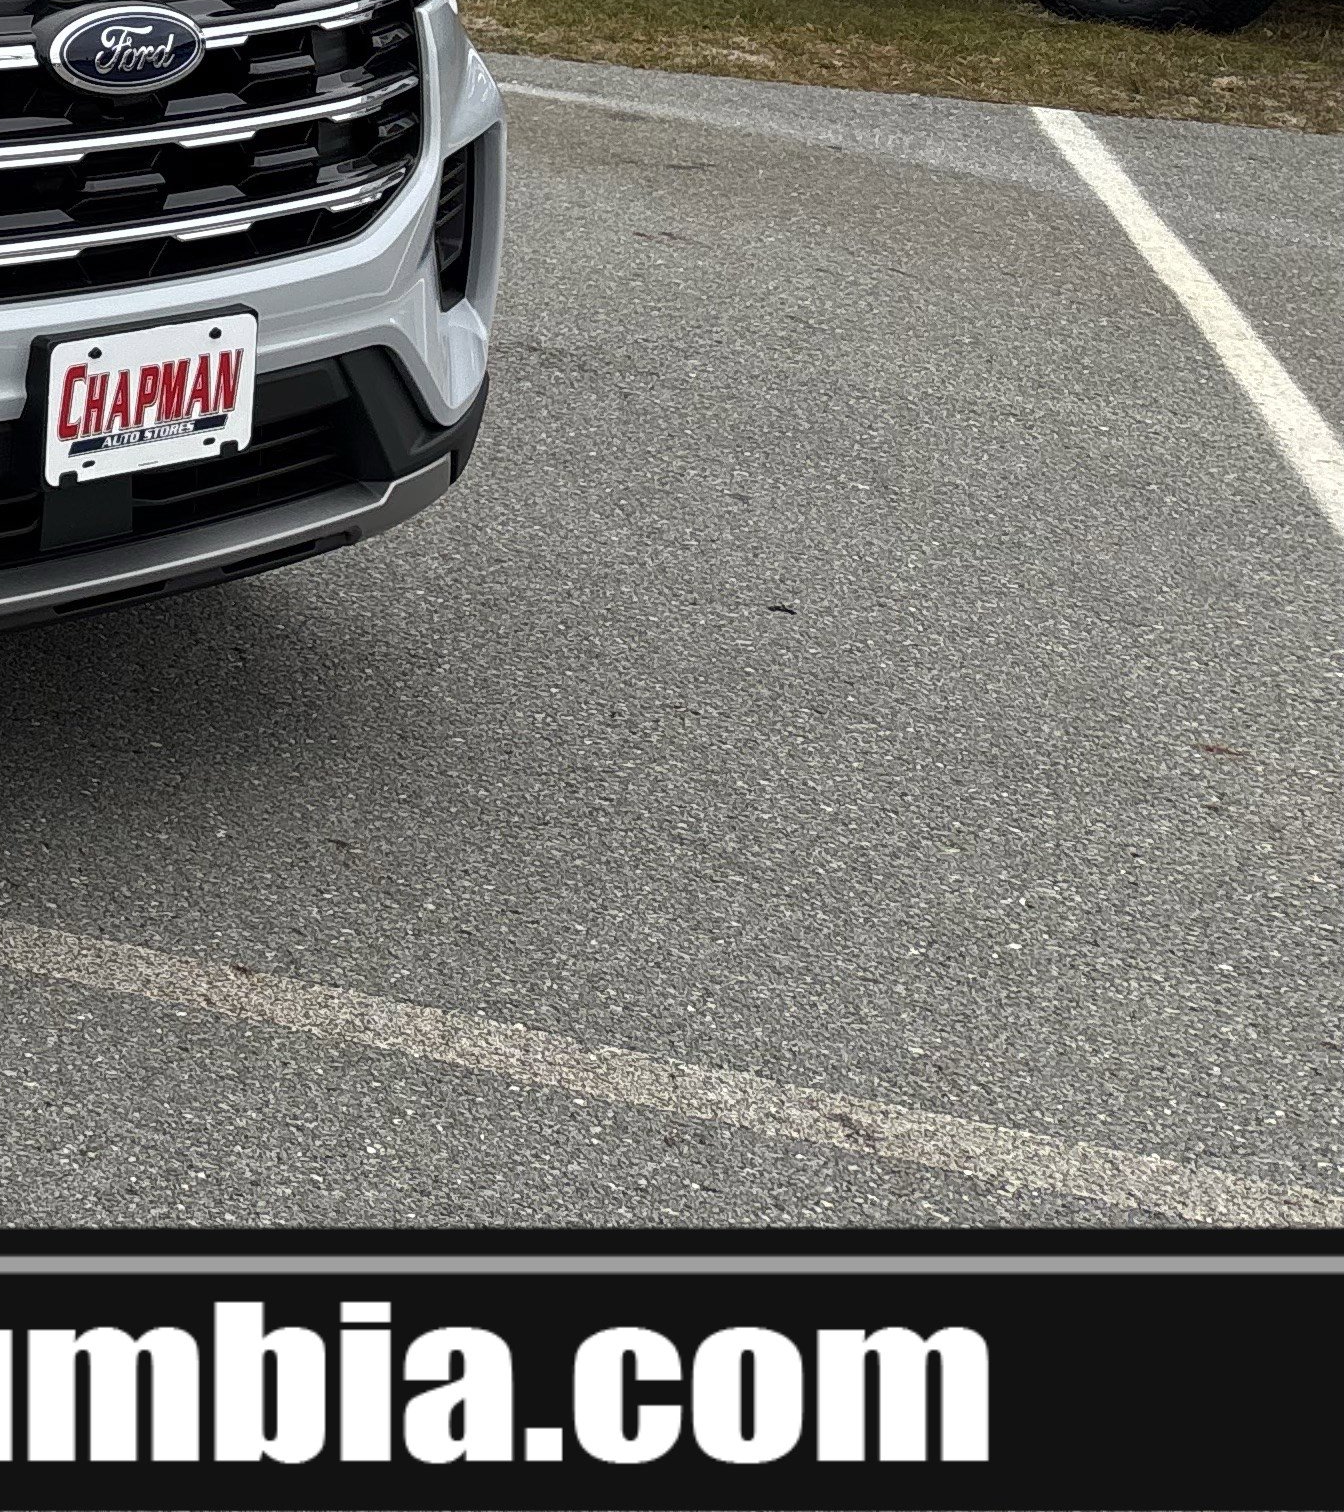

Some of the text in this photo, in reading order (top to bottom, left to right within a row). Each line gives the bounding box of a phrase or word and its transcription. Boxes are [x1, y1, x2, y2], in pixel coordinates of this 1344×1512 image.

[95, 25, 176, 75] Ford
[56, 347, 245, 442] CHAPMAN
[101, 420, 195, 449] AUTO STORES
